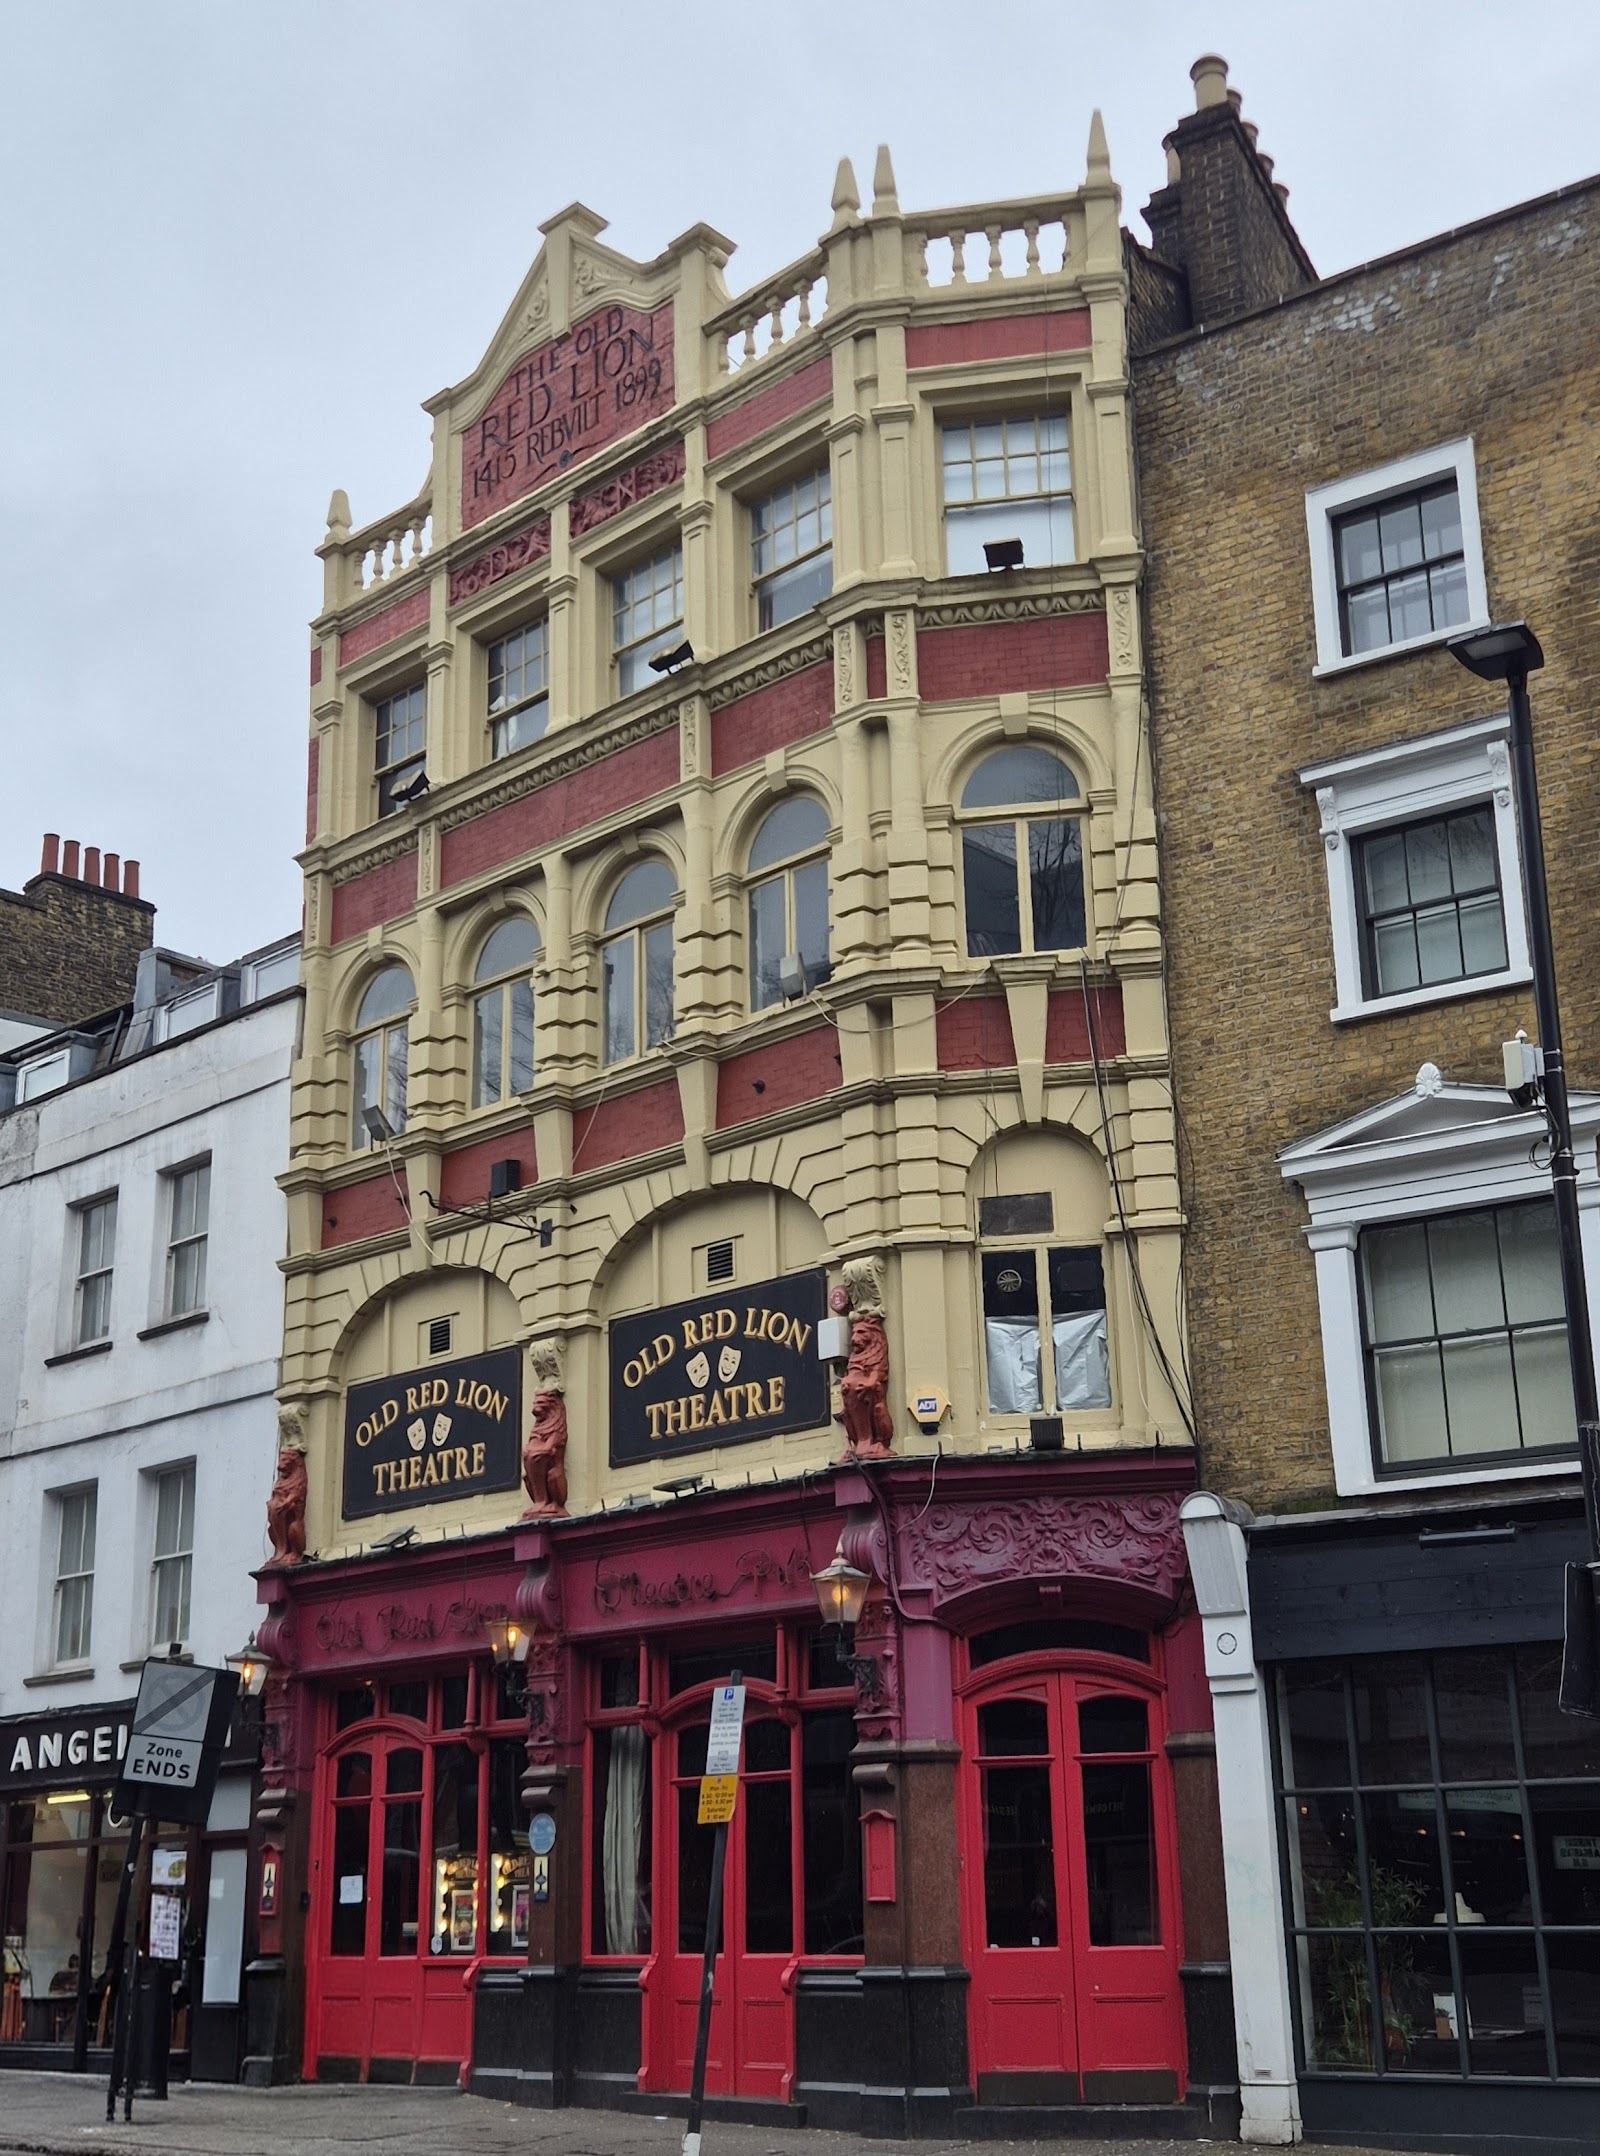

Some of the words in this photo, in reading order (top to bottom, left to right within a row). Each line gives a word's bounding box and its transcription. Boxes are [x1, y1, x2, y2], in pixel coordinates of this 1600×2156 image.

[511, 343, 562, 396] THE
[575, 304, 623, 355] OLD
[480, 383, 552, 458] RED
[571, 316, 654, 402] LION
[473, 446, 517, 498] 1415
[615, 357, 661, 412] 1899
[623, 1334, 676, 1388] OLD
[682, 1308, 738, 1350] RED
[743, 1308, 812, 1355] LION
[355, 1399, 399, 1447] OLD
[405, 1379, 449, 1415] RED
[455, 1378, 509, 1424] LION
[645, 1376, 785, 1440] THEATRE
[918, 1402, 936, 1411] ADT
[373, 1442, 486, 1496] THEATRE
[132, 1759, 191, 1779] ENDS
[146, 1742, 183, 1758] Zone
